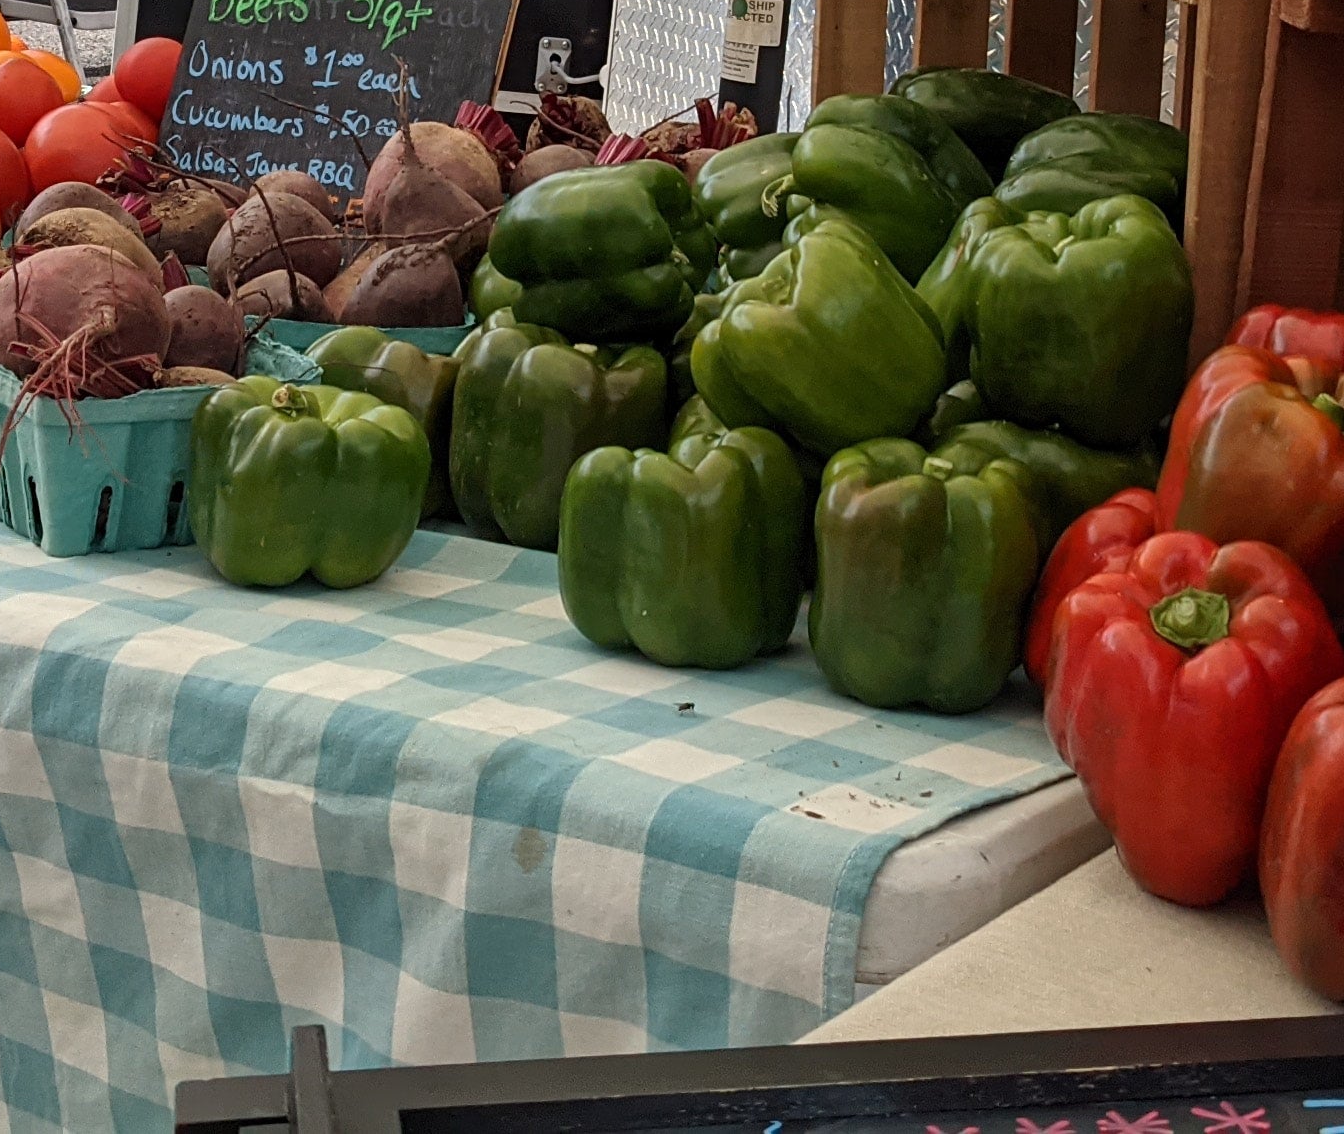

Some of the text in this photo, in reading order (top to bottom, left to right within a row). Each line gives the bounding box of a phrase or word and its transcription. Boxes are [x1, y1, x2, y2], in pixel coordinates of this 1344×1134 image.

[748, 0, 775, 11] SHIP
[188, 40, 286, 86] Onions
[358, 60, 422, 100] each
[171, 90, 304, 138] Cucumbers
